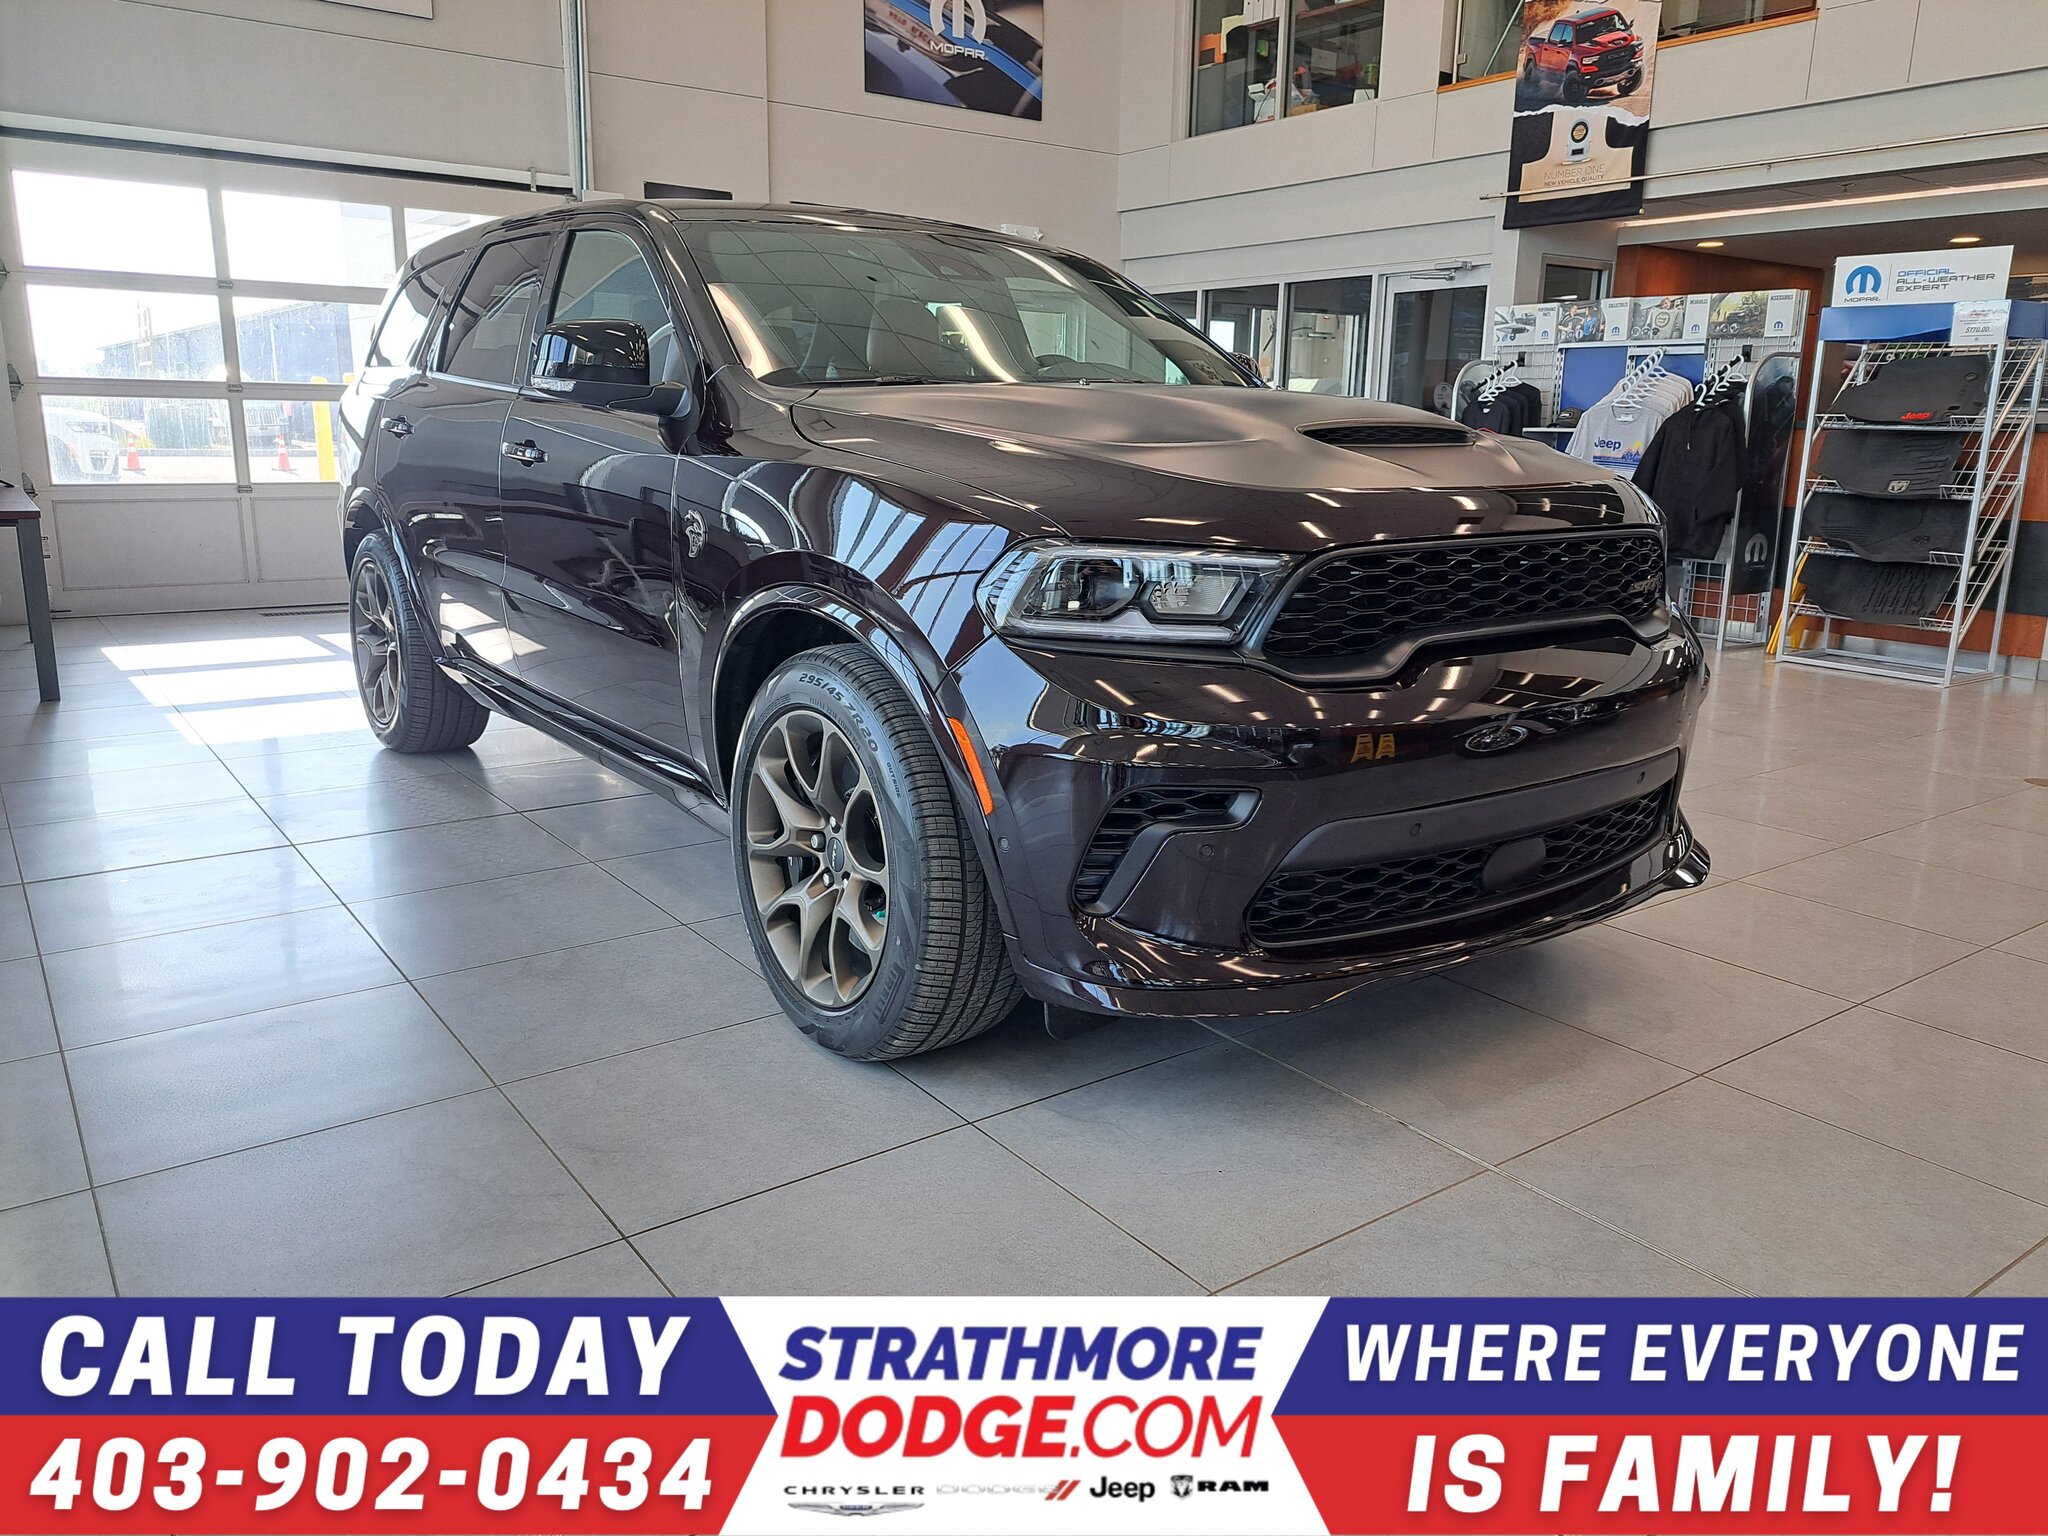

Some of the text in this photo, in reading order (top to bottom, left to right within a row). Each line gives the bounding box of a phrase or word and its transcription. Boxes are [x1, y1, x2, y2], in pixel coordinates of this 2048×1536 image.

[929, 40, 986, 60] MOPAR
[1544, 164, 1605, 180] NUMBER ONE
[1557, 177, 1580, 185] VEHICLE
[1582, 174, 1605, 183] QUALITY
[1897, 267, 1955, 278] OFFICIAL
[1896, 273, 1995, 285] ALL-WEATHER
[1895, 283, 1950, 293] EXPERT
[1900, 412, 1932, 420] Jeep
[1594, 436, 1621, 451] Jeep
[798, 672, 846, 702] 295/45
